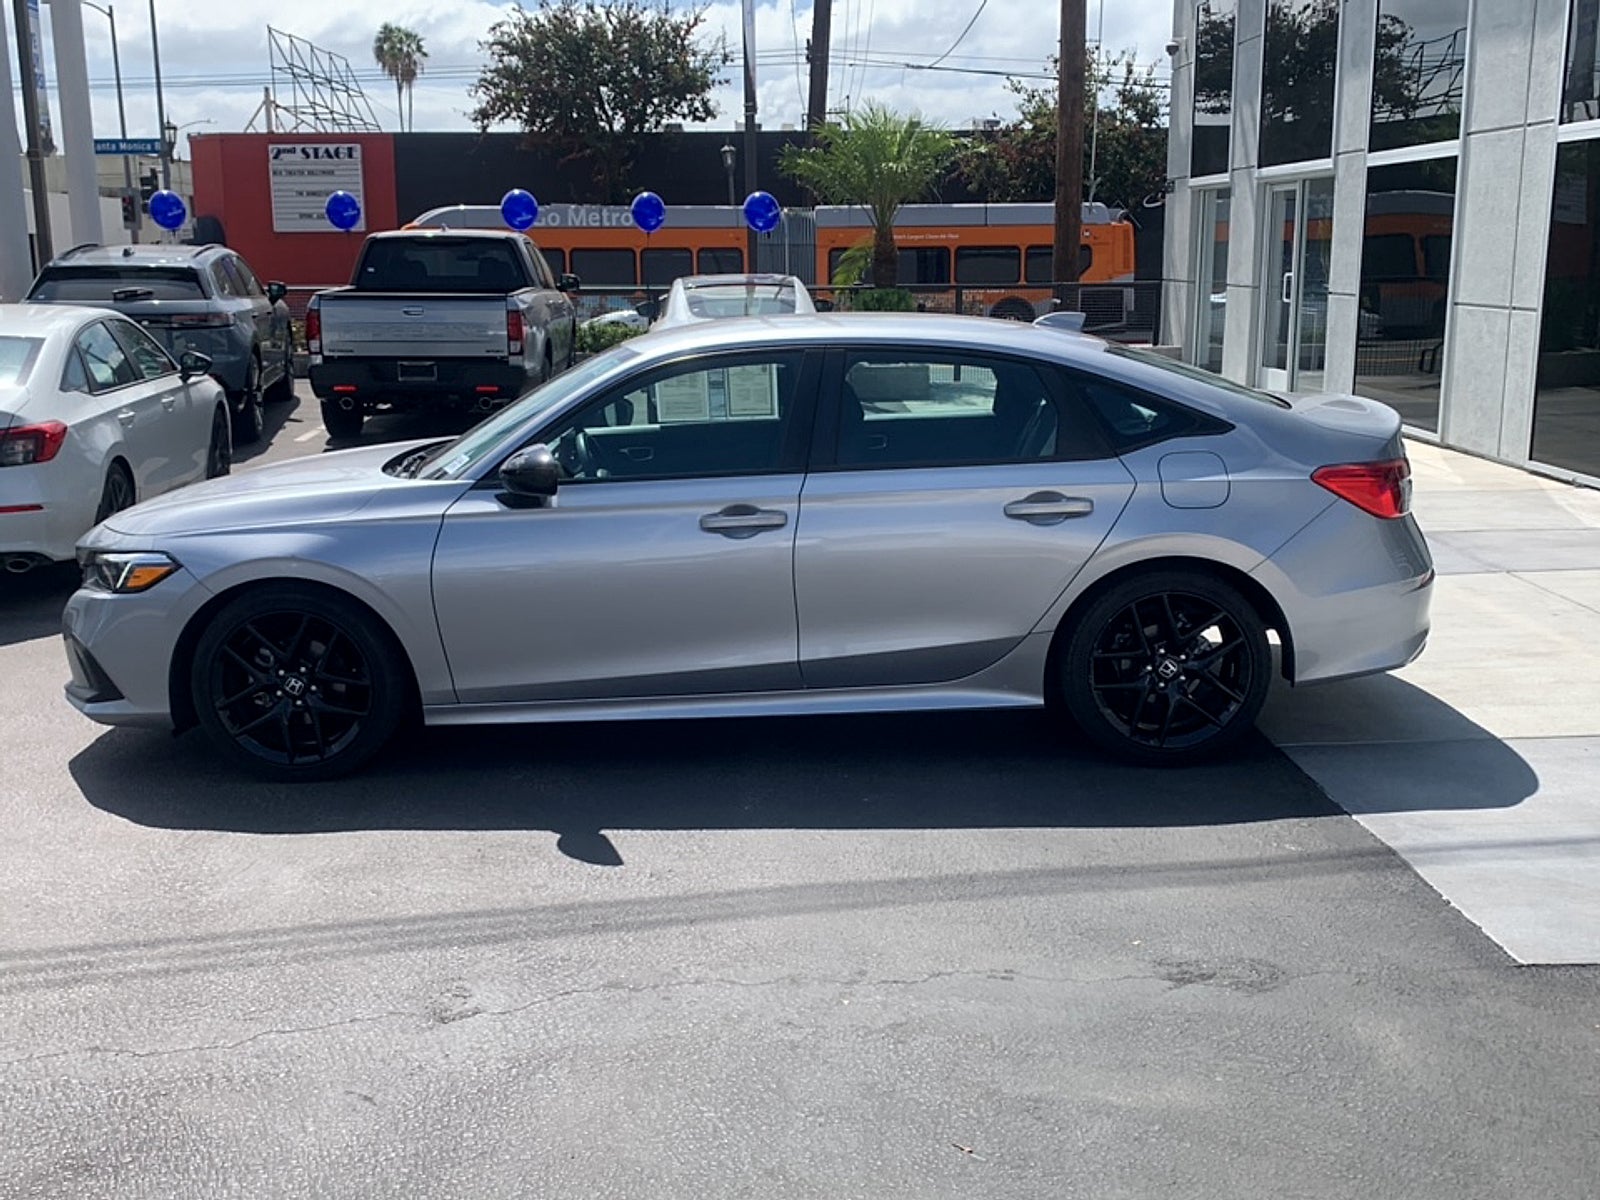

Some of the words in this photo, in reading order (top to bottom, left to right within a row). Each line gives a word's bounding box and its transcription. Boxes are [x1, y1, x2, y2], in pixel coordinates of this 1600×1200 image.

[95, 141, 117, 152] anta
[120, 141, 152, 151] Monica
[272, 146, 297, 160] 2nd
[301, 146, 358, 160] STAGE
[567, 207, 634, 227] Metro
